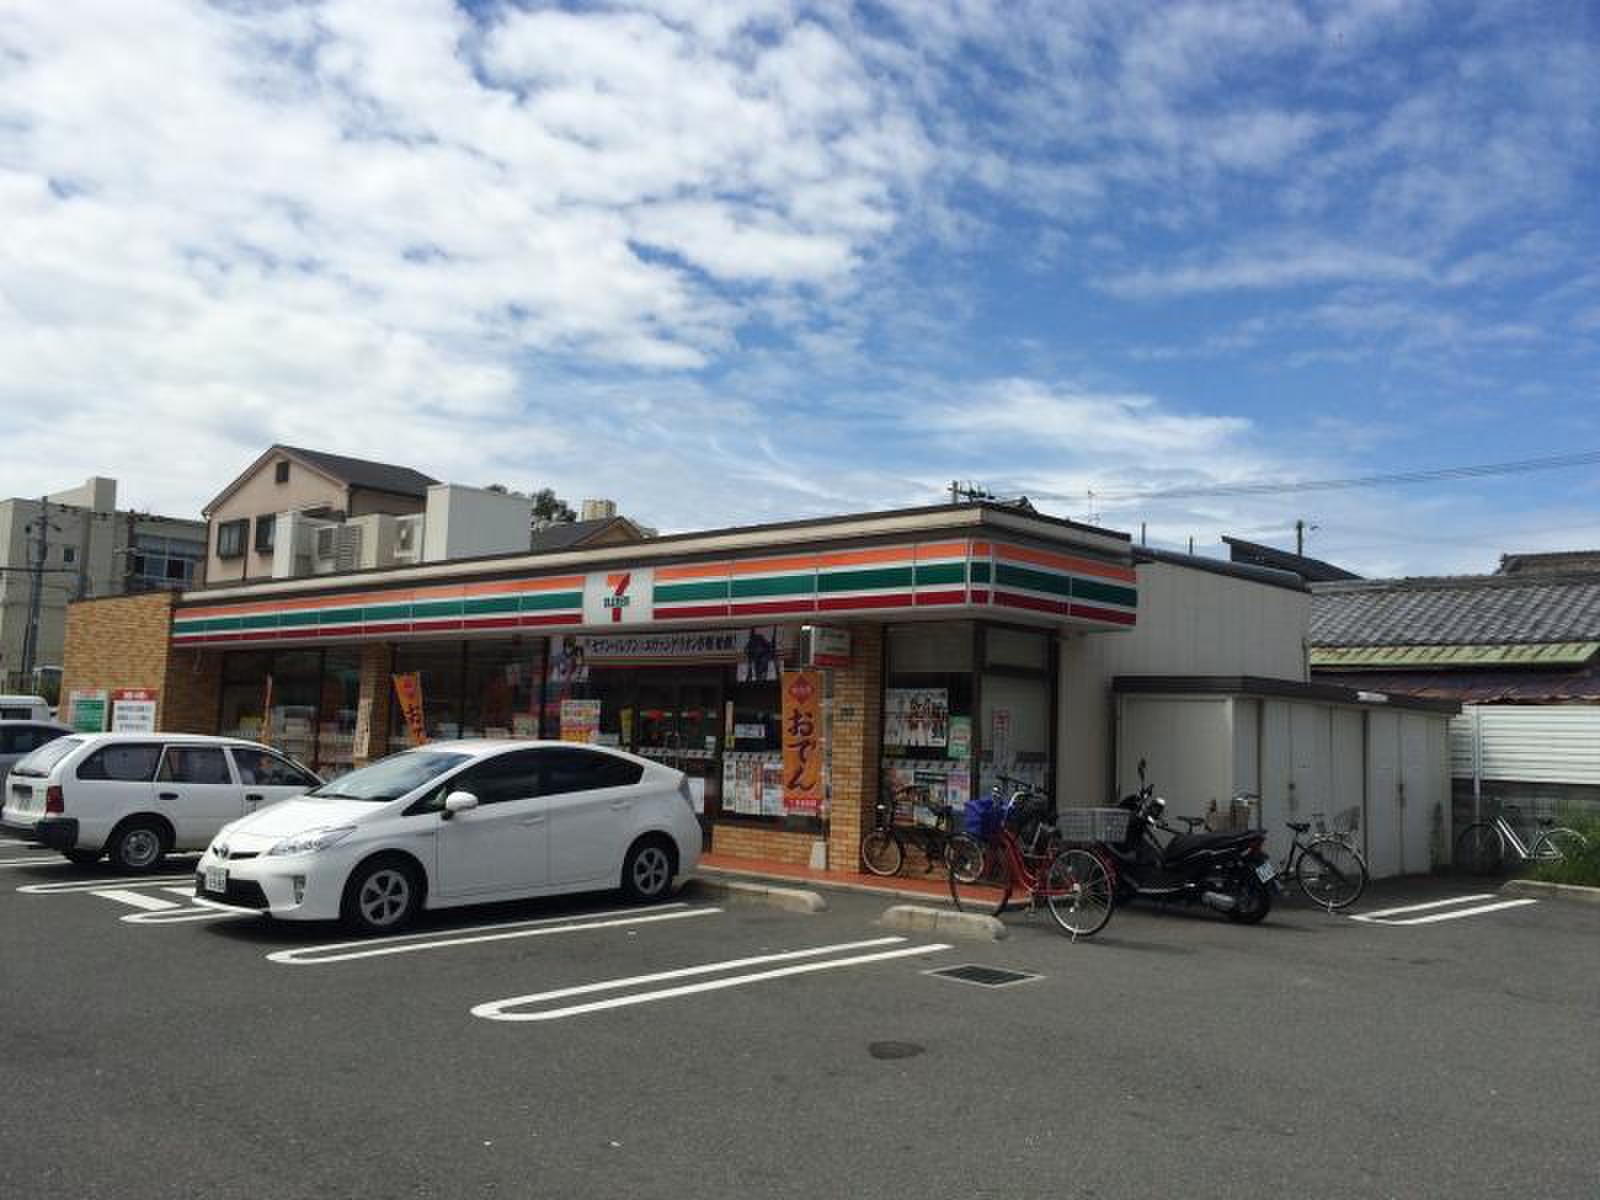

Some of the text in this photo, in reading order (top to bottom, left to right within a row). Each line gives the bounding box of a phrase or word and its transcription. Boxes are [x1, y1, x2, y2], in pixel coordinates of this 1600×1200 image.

[607, 573, 631, 623] 7
[787, 708, 816, 791] おでん
